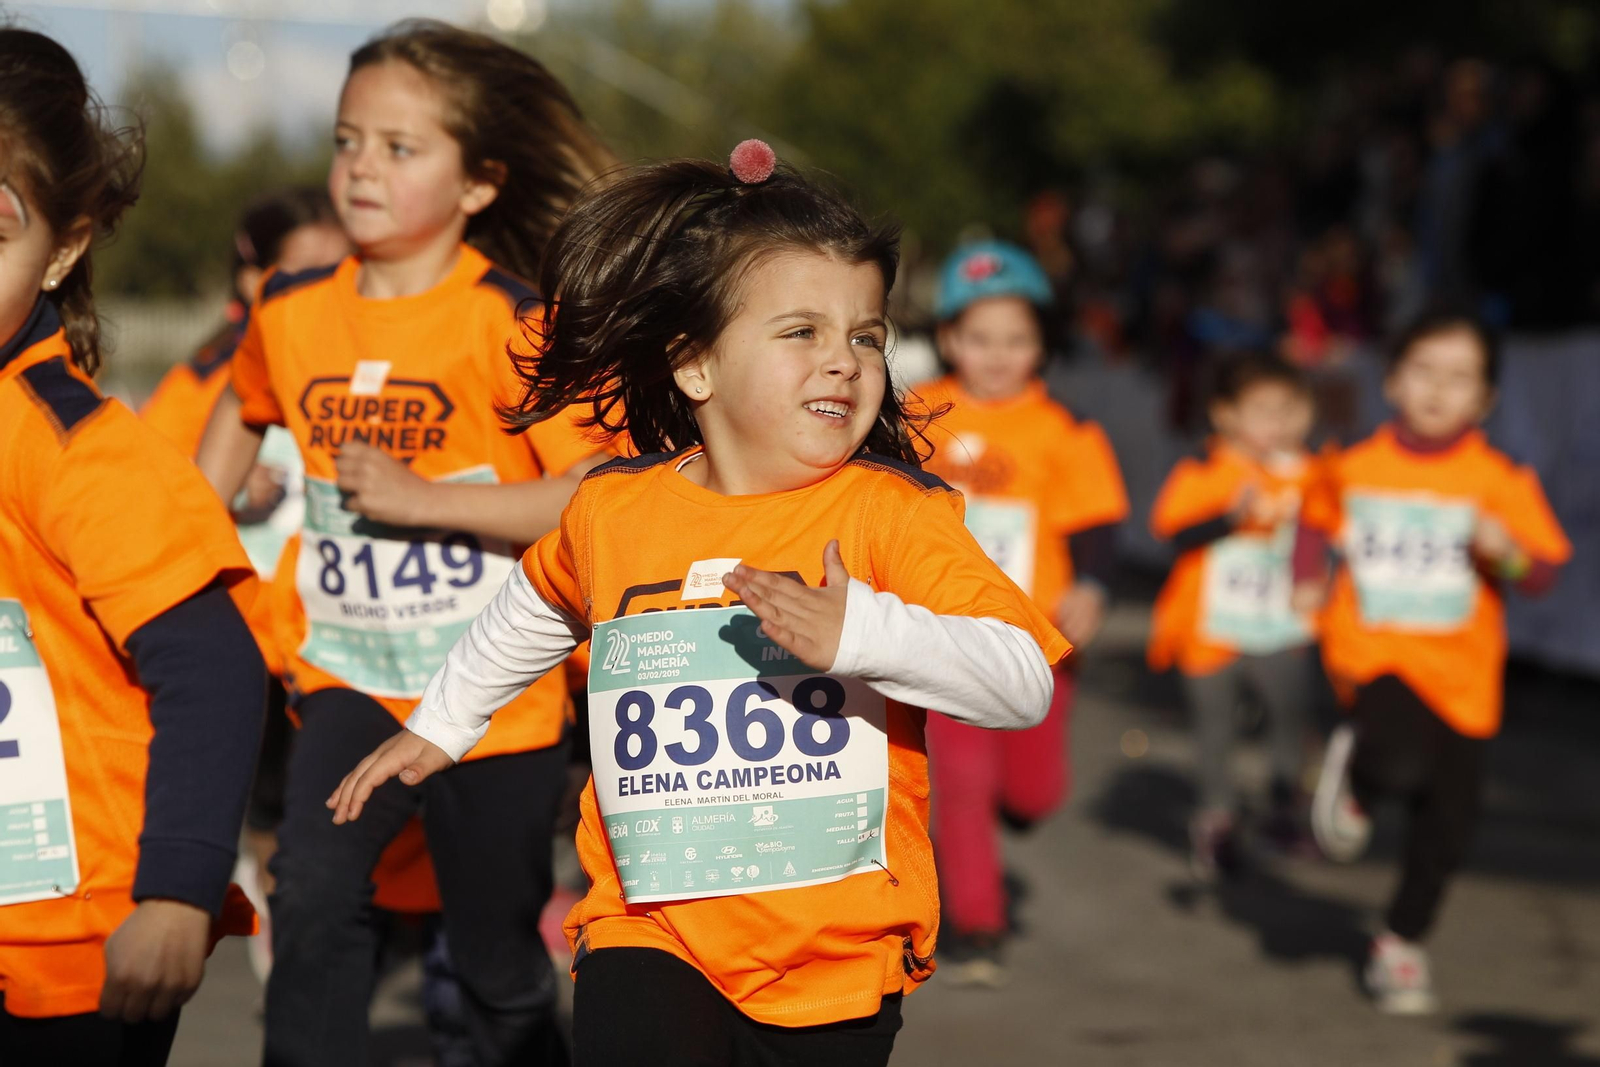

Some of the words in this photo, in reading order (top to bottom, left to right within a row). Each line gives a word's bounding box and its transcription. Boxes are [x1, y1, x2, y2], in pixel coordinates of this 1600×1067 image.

[319, 396, 426, 422] SUPER
[309, 425, 447, 450] RUNNER
[317, 532, 485, 600] 8149
[637, 630, 674, 644] MEDIO
[637, 640, 697, 658] MARATÓN
[637, 654, 690, 672] ALMERÍA
[637, 669, 681, 681] 03/02/2019
[614, 676, 851, 771] 8368
[618, 772, 688, 797] ELENA
[696, 761, 842, 790] CAMPEONA
[664, 797, 693, 807] ELENA
[732, 792, 751, 802] DEL
[752, 791, 784, 802] MORAL
[836, 797, 854, 805] AGUA
[691, 811, 736, 825] ALMERÍA
[834, 811, 855, 819] FRUTA
[635, 818, 660, 834] CDX
[691, 824, 715, 832] CIUDAD
[826, 824, 855, 833] MEDALLA
[836, 837, 855, 845] TALLA
